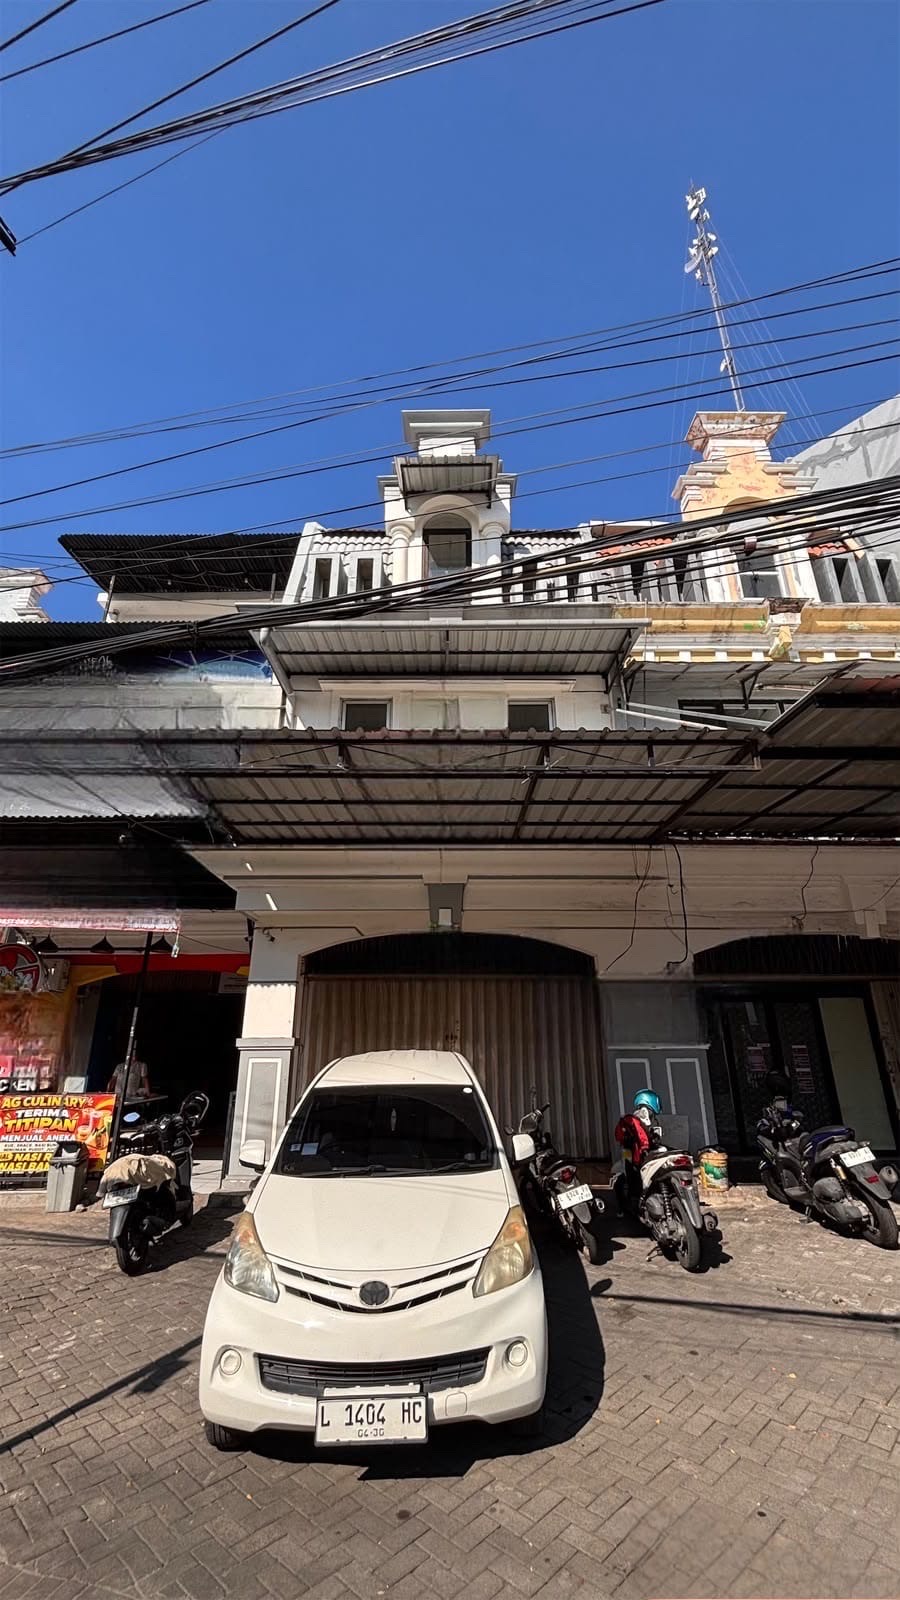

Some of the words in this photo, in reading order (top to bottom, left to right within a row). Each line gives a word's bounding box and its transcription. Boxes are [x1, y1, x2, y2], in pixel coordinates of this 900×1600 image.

[15, 1109, 69, 1118] TERIMA
[4, 1117, 77, 1133] TITIPAN
[14, 1153, 42, 1161] NASI
[321, 1405, 330, 1427] L
[345, 1402, 386, 1426] 1404
[402, 1401, 422, 1424] HC
